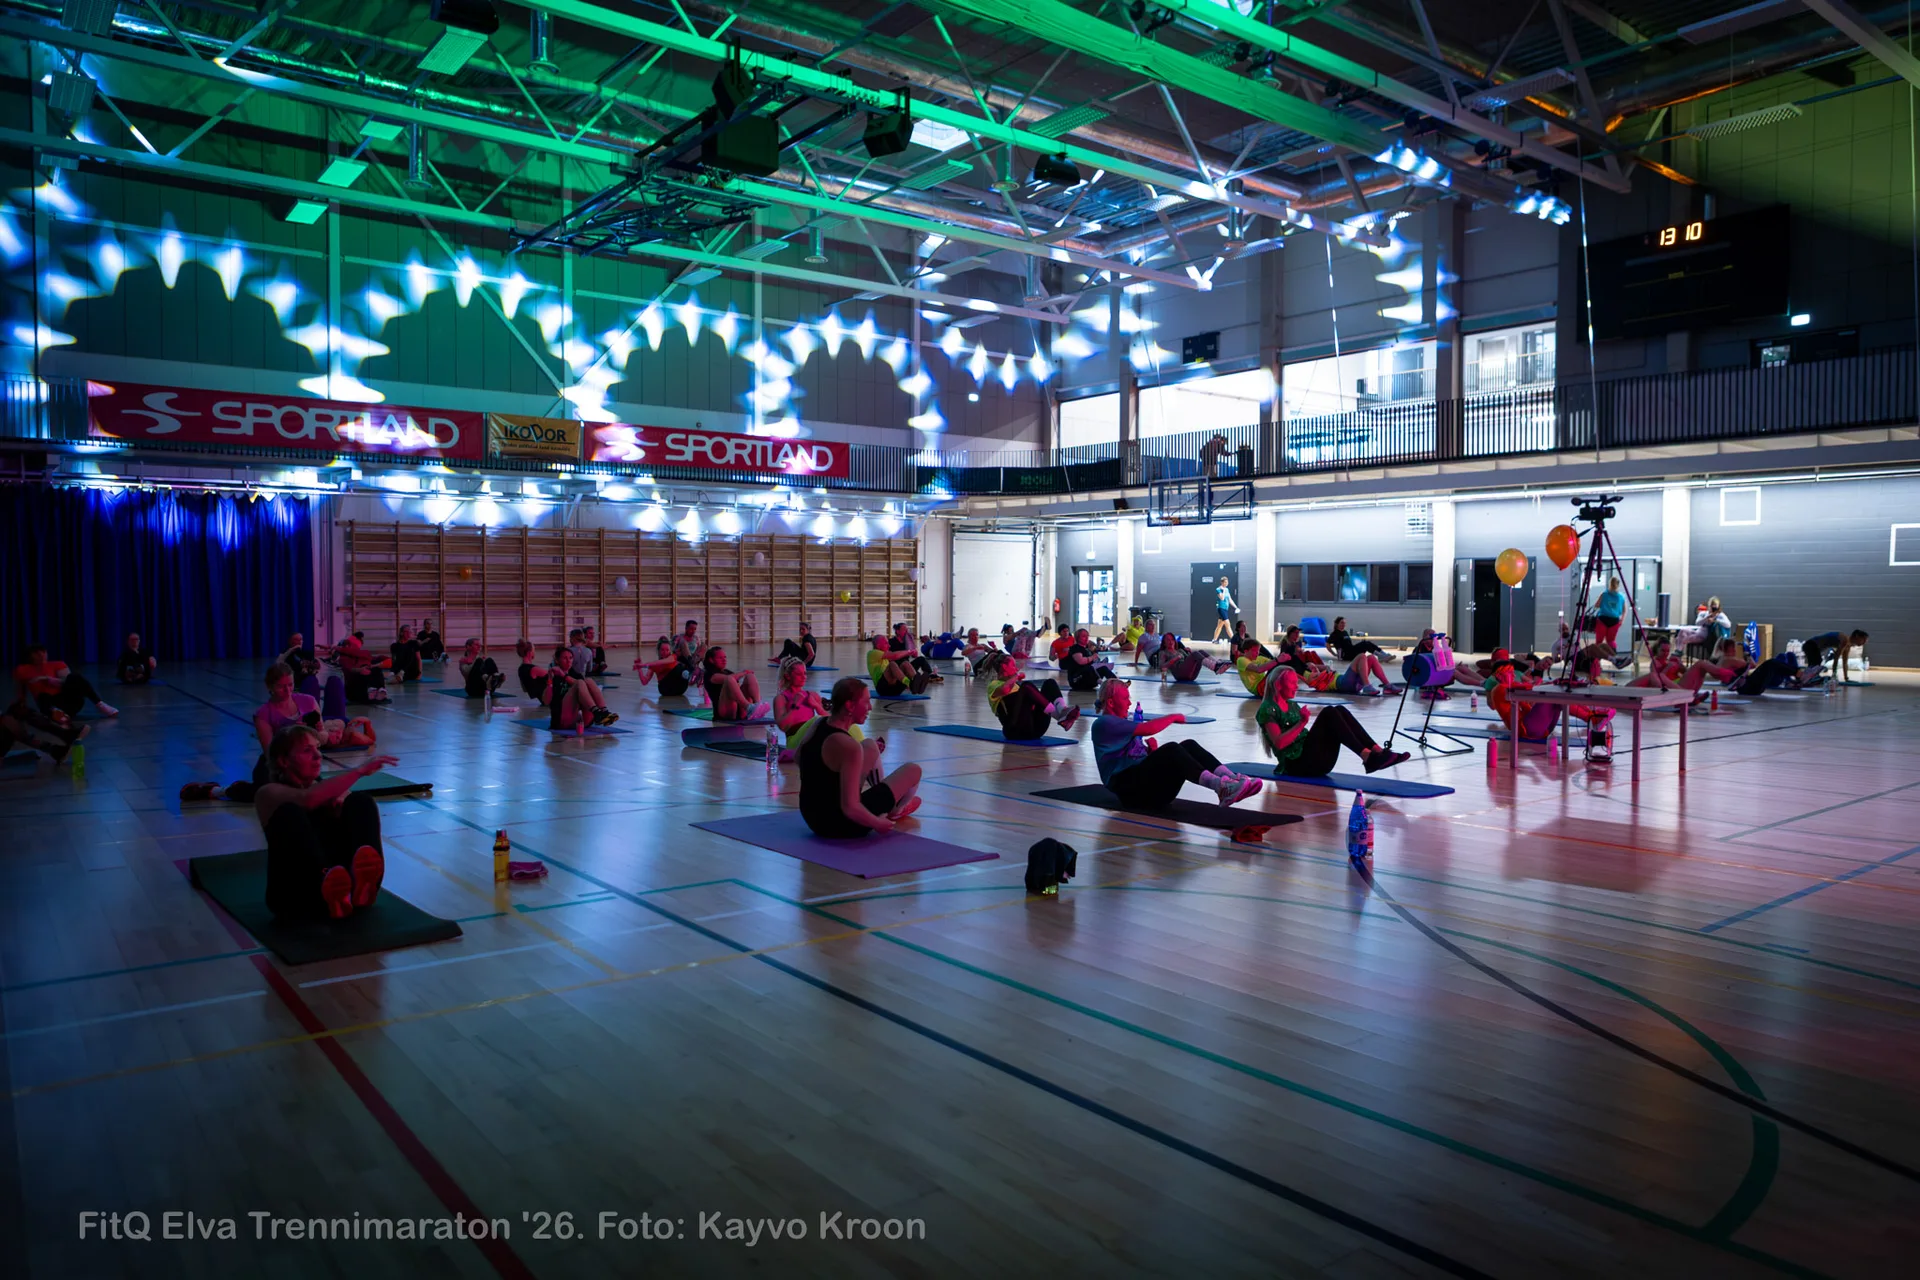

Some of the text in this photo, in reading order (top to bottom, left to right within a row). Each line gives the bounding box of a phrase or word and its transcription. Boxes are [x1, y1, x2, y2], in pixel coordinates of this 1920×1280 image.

[1659, 221, 1703, 246] 13 10
[211, 401, 460, 449] SPORTLAND
[504, 423, 567, 442] IKODOR
[665, 433, 833, 472] SPORTLAND
